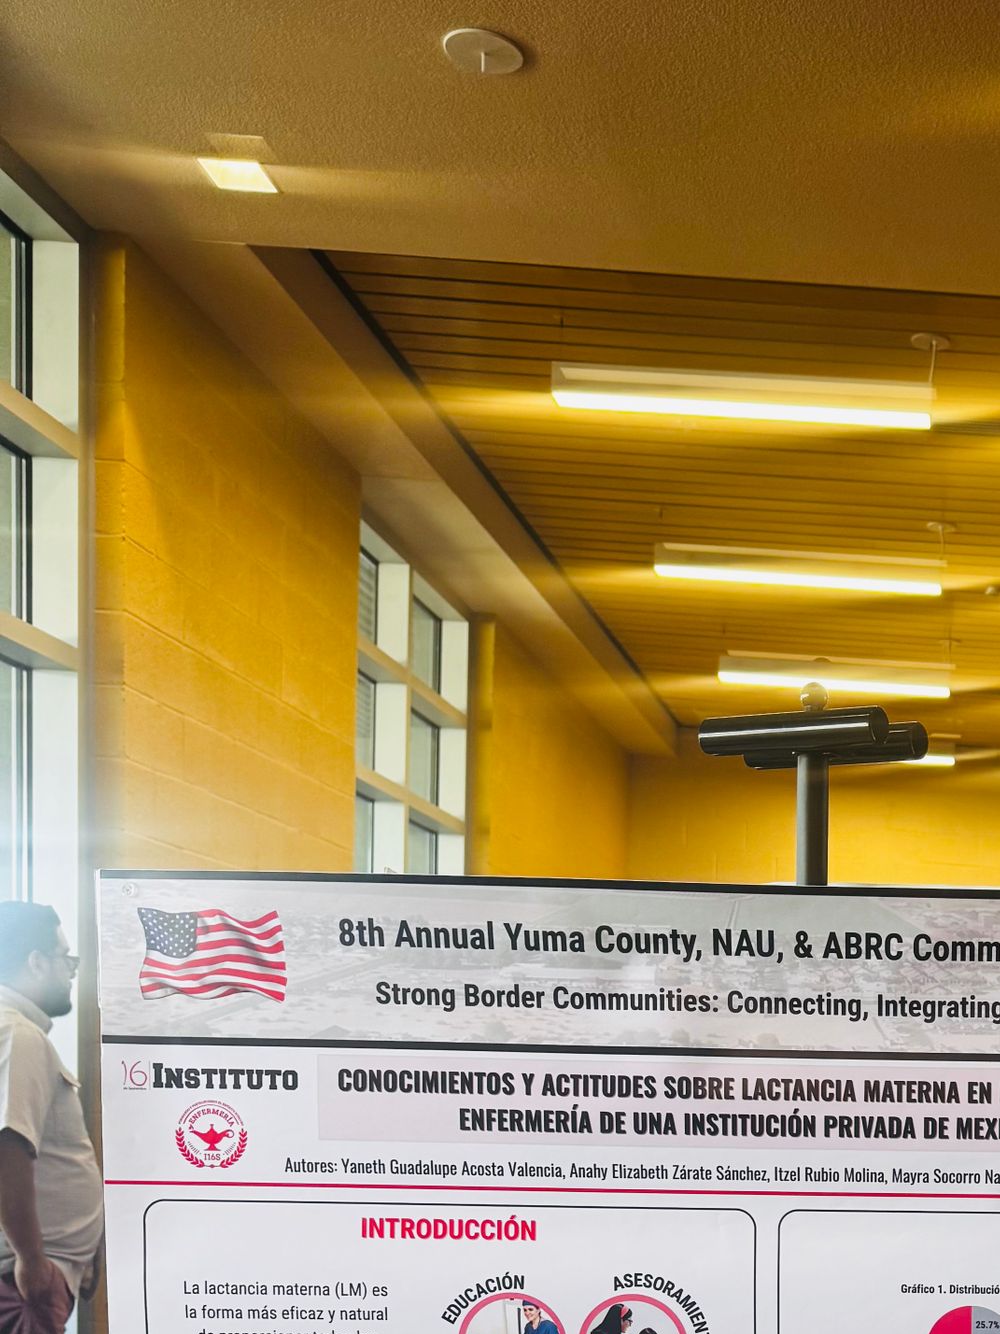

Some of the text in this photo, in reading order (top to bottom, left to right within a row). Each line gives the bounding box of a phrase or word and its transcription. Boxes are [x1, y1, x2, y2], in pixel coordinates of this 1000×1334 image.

[338, 917, 385, 947] 8th
[394, 919, 495, 950] Annual
[502, 922, 585, 952] Yuma
[594, 924, 703, 961] County,
[712, 927, 784, 964] NAU,
[793, 930, 813, 958] &
[821, 931, 903, 961] ABRC
[375, 981, 455, 1012] Strong
[463, 983, 545, 1009] Border
[552, 985, 718, 1012] Communities:
[727, 989, 868, 1021] Connecting,
[152, 1062, 299, 1090] INSTITUTO
[337, 1068, 515, 1095] CONOCIMIENTOS
[521, 1072, 535, 1096] Y
[541, 1073, 657, 1099] ACTITUDES
[663, 1075, 735, 1100] SOBRE
[741, 1077, 857, 1102] LACTANCIA
[863, 1079, 960, 1104] MATERNA
[967, 1081, 992, 1104] EN
[189, 1107, 235, 1127] ENFERMERÍA
[459, 1104, 593, 1133] ENFERMERÍA
[599, 1110, 627, 1134] DE
[632, 1111, 677, 1135] UNA
[683, 1108, 816, 1138] INSTITUCIÓN
[823, 1114, 916, 1139] PRIVADA
[923, 1116, 949, 1139] DE
[284, 1156, 337, 1173] Autores:
[340, 1157, 386, 1174] Yaneth
[389, 1158, 457, 1178] Guadalupe
[461, 1160, 504, 1176] Acosta
[507, 1161, 565, 1179] Valencia,
[569, 1162, 608, 1181] Anahy
[611, 1163, 668, 1180] Elizabeth
[672, 1164, 712, 1180] Zárate
[715, 1165, 770, 1183] Sánchez,
[774, 1166, 800, 1182] Itzel
[804, 1166, 839, 1182] Rubio
[843, 1167, 888, 1185] Molina,
[891, 1167, 929, 1185] Mayra
[933, 1168, 980, 1184] Socorro
[361, 1214, 536, 1241] INTRODUCCIÓN
[183, 1279, 388, 1300] La lactancia materna (LM) es
[441, 1271, 525, 1325] EDUCACIÓN
[900, 1283, 935, 1293] Gráfico
[937, 1284, 946, 1294] 1.
[975, 1320, 1000, 1329] 25.7%
